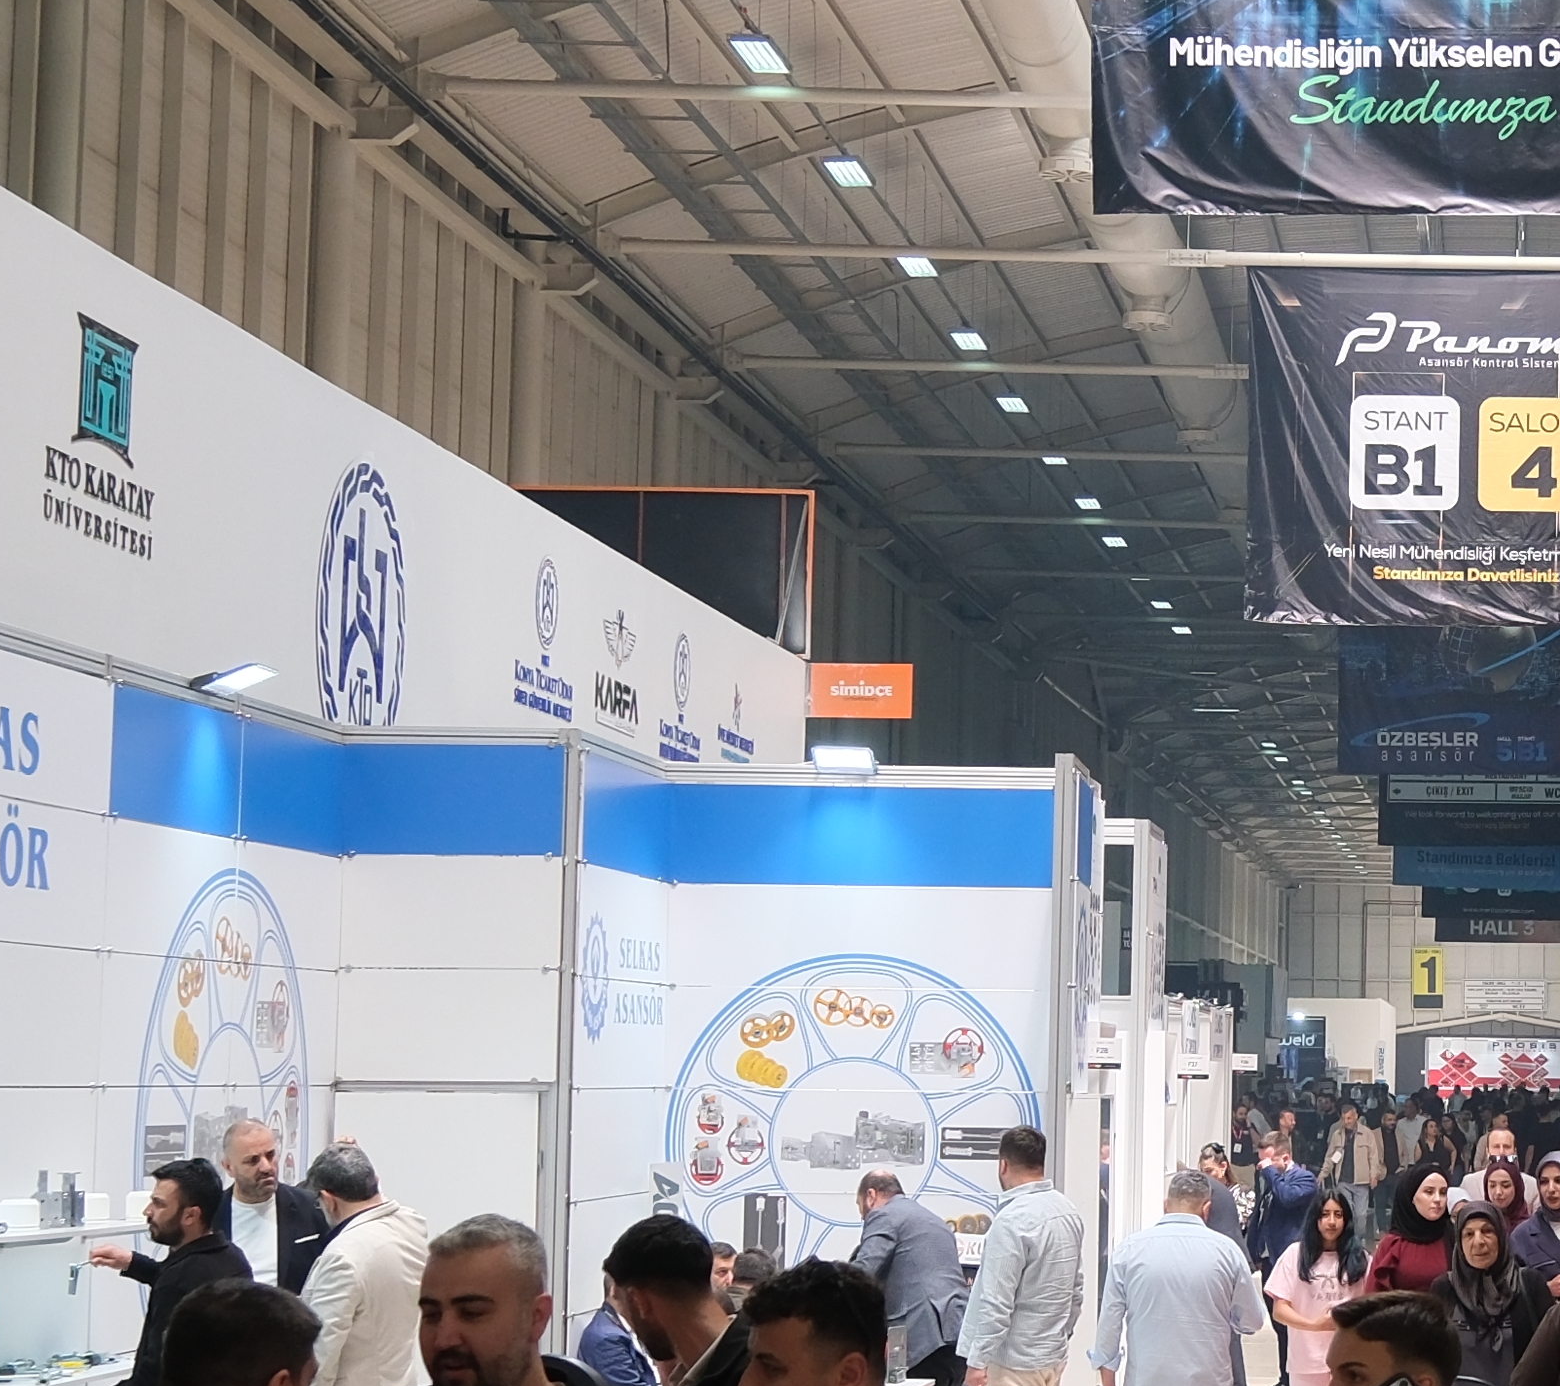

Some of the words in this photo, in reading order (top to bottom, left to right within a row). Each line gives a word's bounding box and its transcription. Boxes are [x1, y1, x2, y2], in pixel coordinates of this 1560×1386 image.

[1169, 36, 1382, 75] Mühendisliğin
[1389, 38, 1533, 69] Yükselen
[1290, 73, 1558, 140] Standımıza
[1419, 356, 1469, 368] Asansör
[1473, 357, 1519, 369] Kontrol
[1364, 411, 1449, 431] STANT
[44, 445, 82, 490] KTO
[83, 462, 155, 522] KARATAY
[1364, 443, 1443, 497] B1
[1511, 446, 1558, 498] 4
[43, 488, 153, 561] ÜNİVERSİTESİ
[1323, 542, 1356, 559] Yeni
[1360, 544, 1397, 561] Nesil
[1400, 544, 1496, 566] Mühendisliği
[1372, 566, 1465, 582] Standımıza
[1467, 567, 1560, 583] Davetlisiniz
[1376, 728, 1479, 751] ÖZBEŞLER
[1380, 747, 1476, 762] asansör
[1426, 785, 1449, 798] ÇIKIŞ
[1456, 785, 1475, 796] EXIT
[1469, 919, 1515, 936] HALL
[1522, 919, 1535, 936] 3
[619, 936, 661, 972] SELKAS
[1420, 956, 1437, 993] 1
[613, 986, 664, 1026] ASANSÖR
